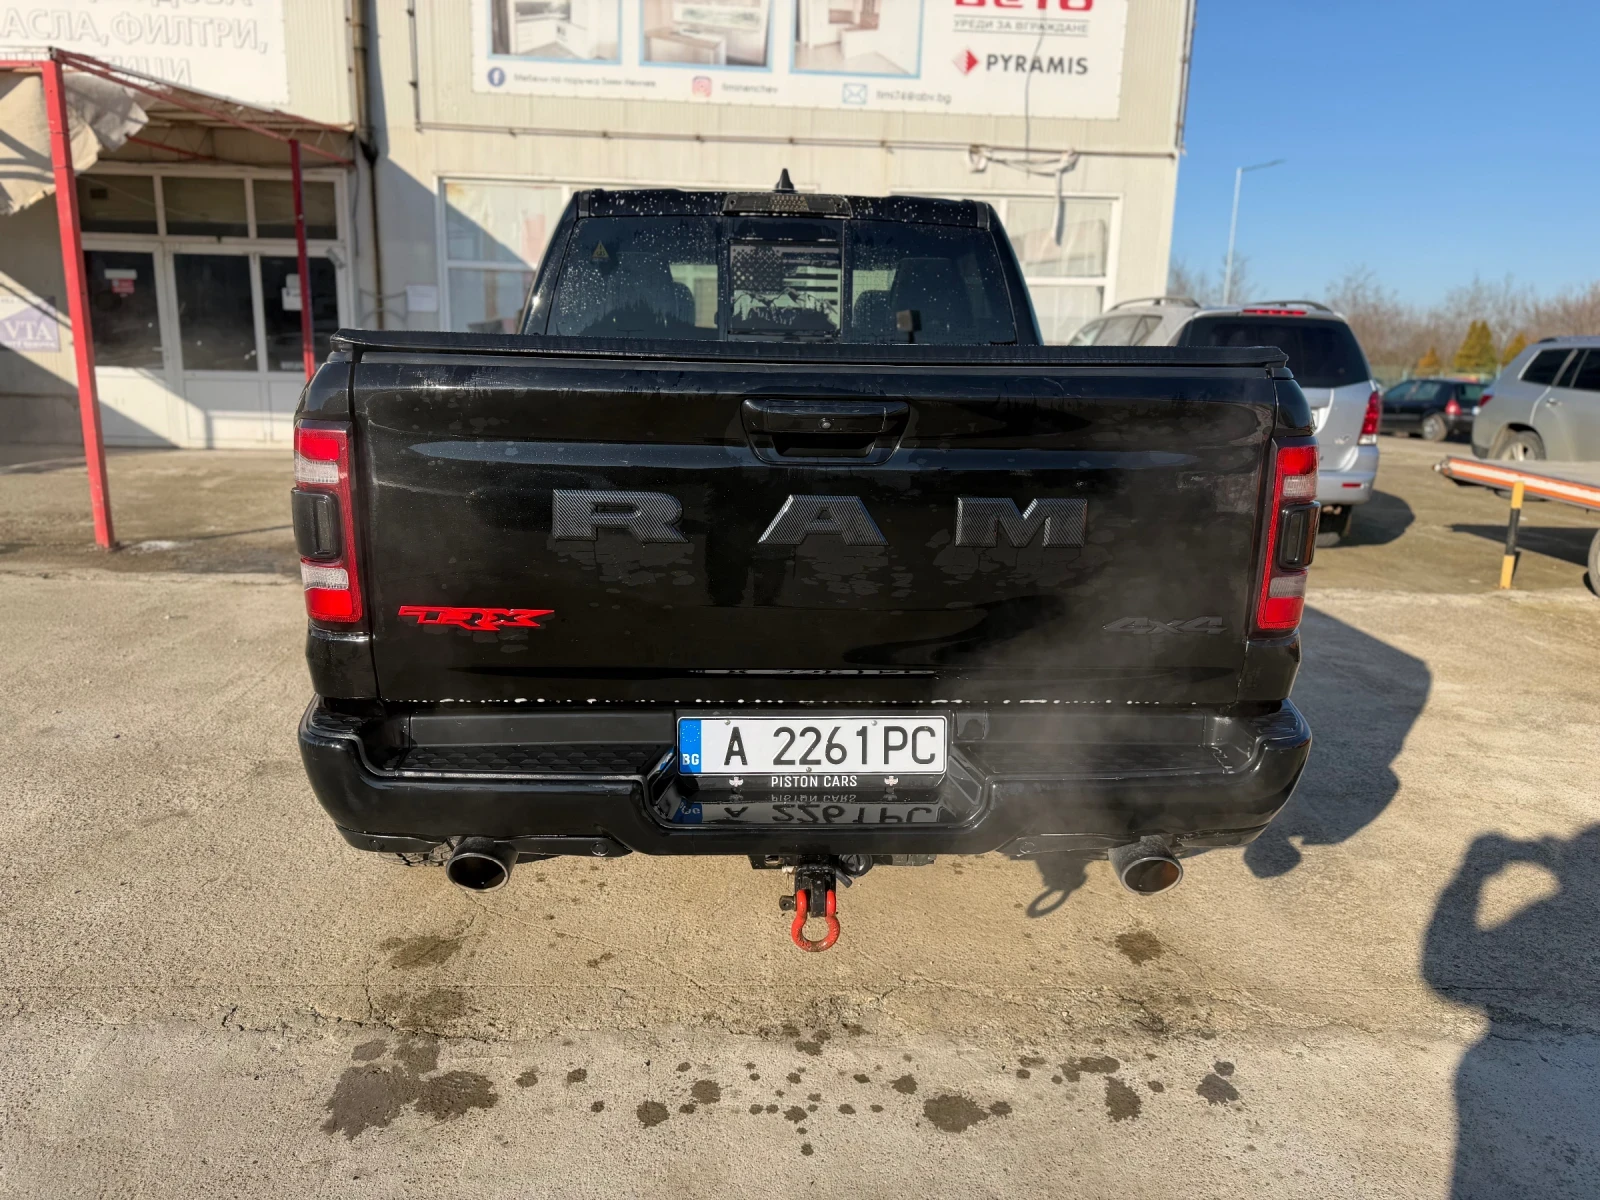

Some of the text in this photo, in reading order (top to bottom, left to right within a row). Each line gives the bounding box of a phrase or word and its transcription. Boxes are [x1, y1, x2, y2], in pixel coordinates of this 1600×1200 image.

[954, 19, 1088, 34] УРЕДИ ЗА ВГРАЖДАНЕ
[985, 53, 1089, 76] PYRAMIS
[552, 489, 1088, 548] RAM
[398, 605, 555, 631] TRX
[723, 726, 748, 767] A
[682, 753, 700, 766] BG
[771, 775, 858, 788] PISTON CARS
